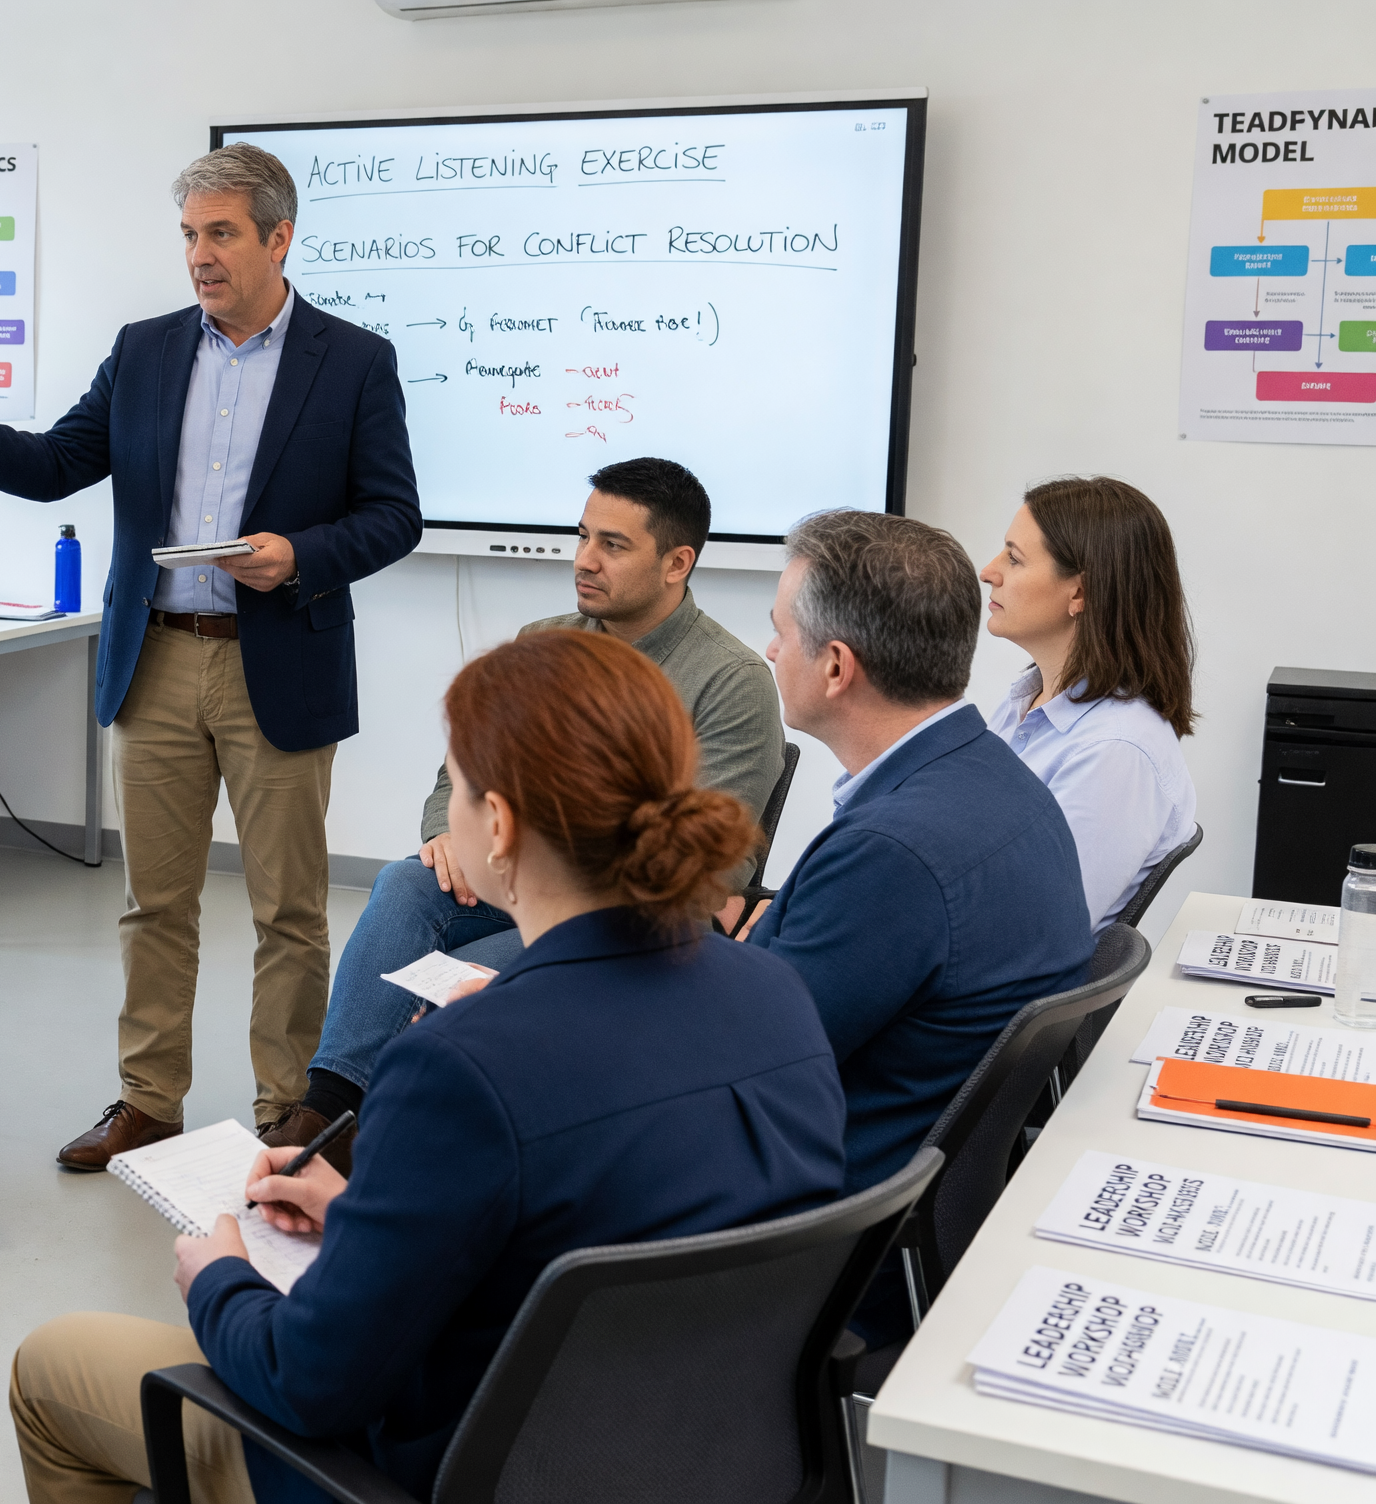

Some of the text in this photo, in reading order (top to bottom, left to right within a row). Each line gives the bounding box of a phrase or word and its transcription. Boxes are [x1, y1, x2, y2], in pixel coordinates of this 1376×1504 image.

[1213, 107, 1376, 134] TEADFYNA
[307, 154, 395, 188] ACTIVE
[580, 141, 726, 175] EXERCISE
[1211, 140, 1315, 165] MODEL
[301, 223, 838, 263] SCENARIOS FOR CONFLICT RESOLUTION
[1057, 1294, 1129, 1380] WORKSHOP
